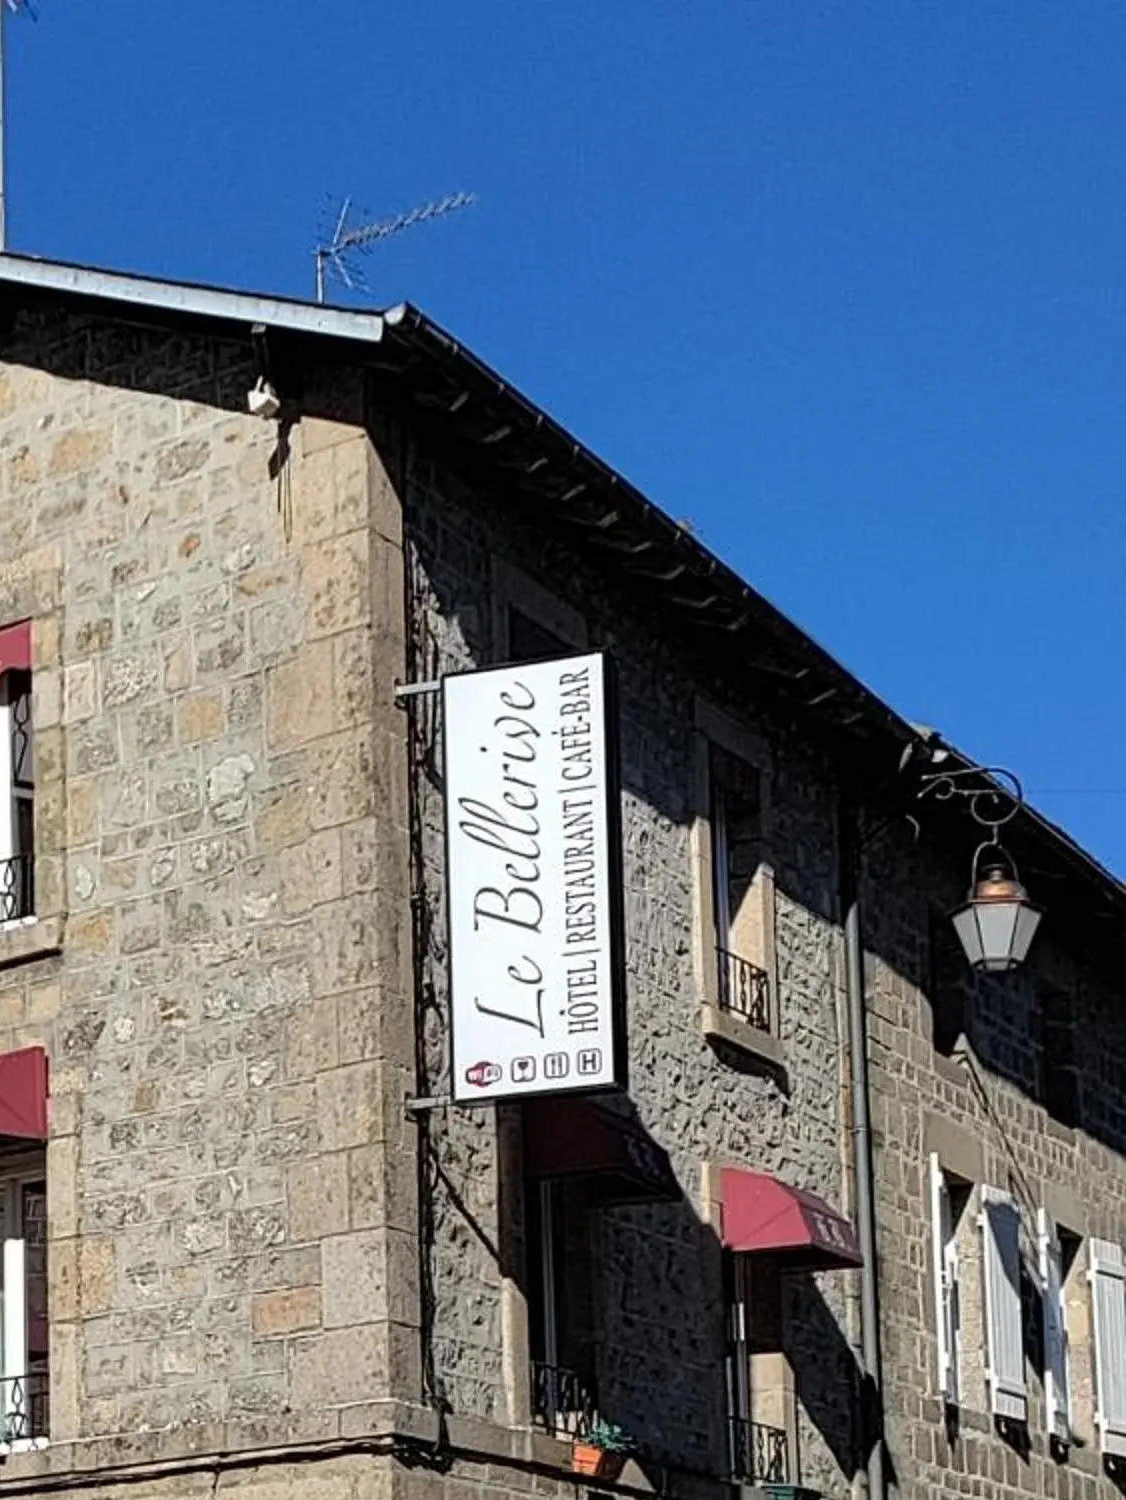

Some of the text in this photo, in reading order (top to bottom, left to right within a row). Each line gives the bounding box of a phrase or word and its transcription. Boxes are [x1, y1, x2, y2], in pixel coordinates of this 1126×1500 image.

[458, 681, 545, 1039] Le Bellerive
[551, 667, 599, 1035] HÔTEL RESTAURANT CAFÉ-BAR
